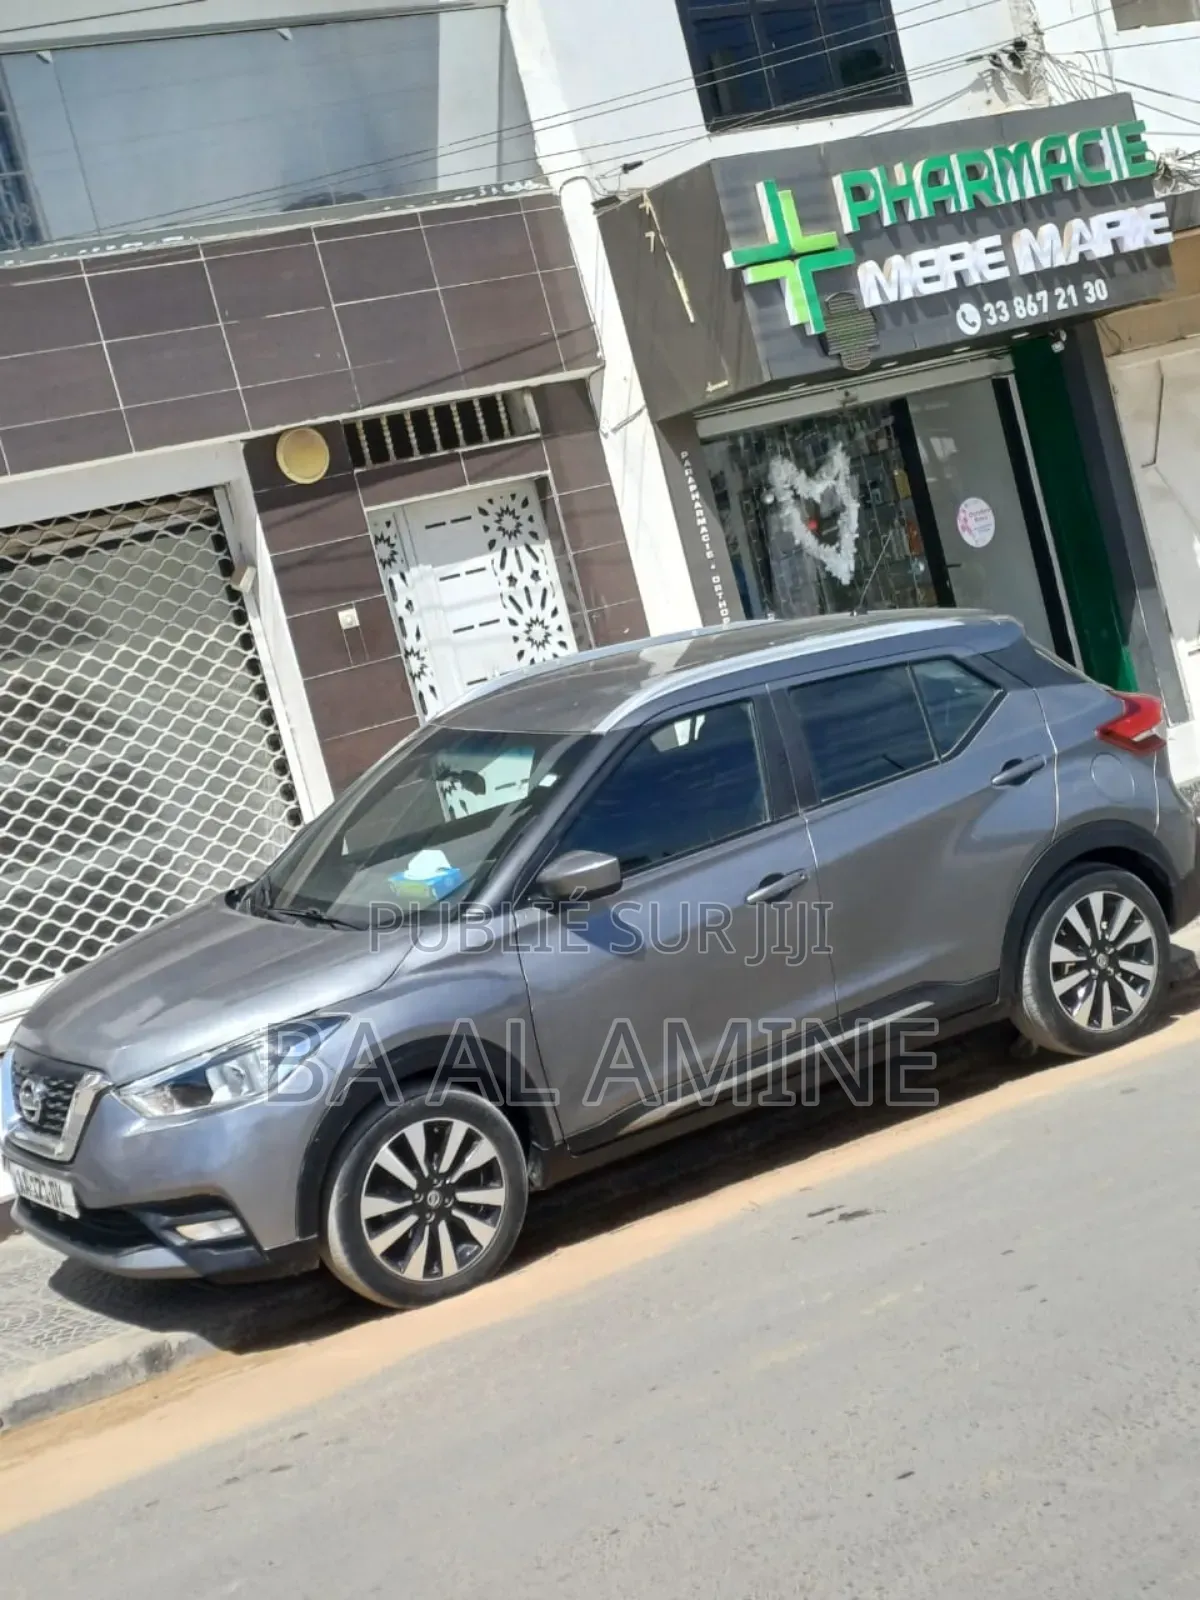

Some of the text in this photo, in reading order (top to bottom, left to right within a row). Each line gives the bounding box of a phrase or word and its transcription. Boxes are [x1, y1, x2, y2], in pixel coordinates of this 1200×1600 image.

[832, 120, 1157, 233] PHARMACIE
[857, 201, 1174, 308] MERE MARIE
[983, 278, 1108, 326] 33 867 21 30
[681, 451, 714, 559] PARAPHARMACIE
